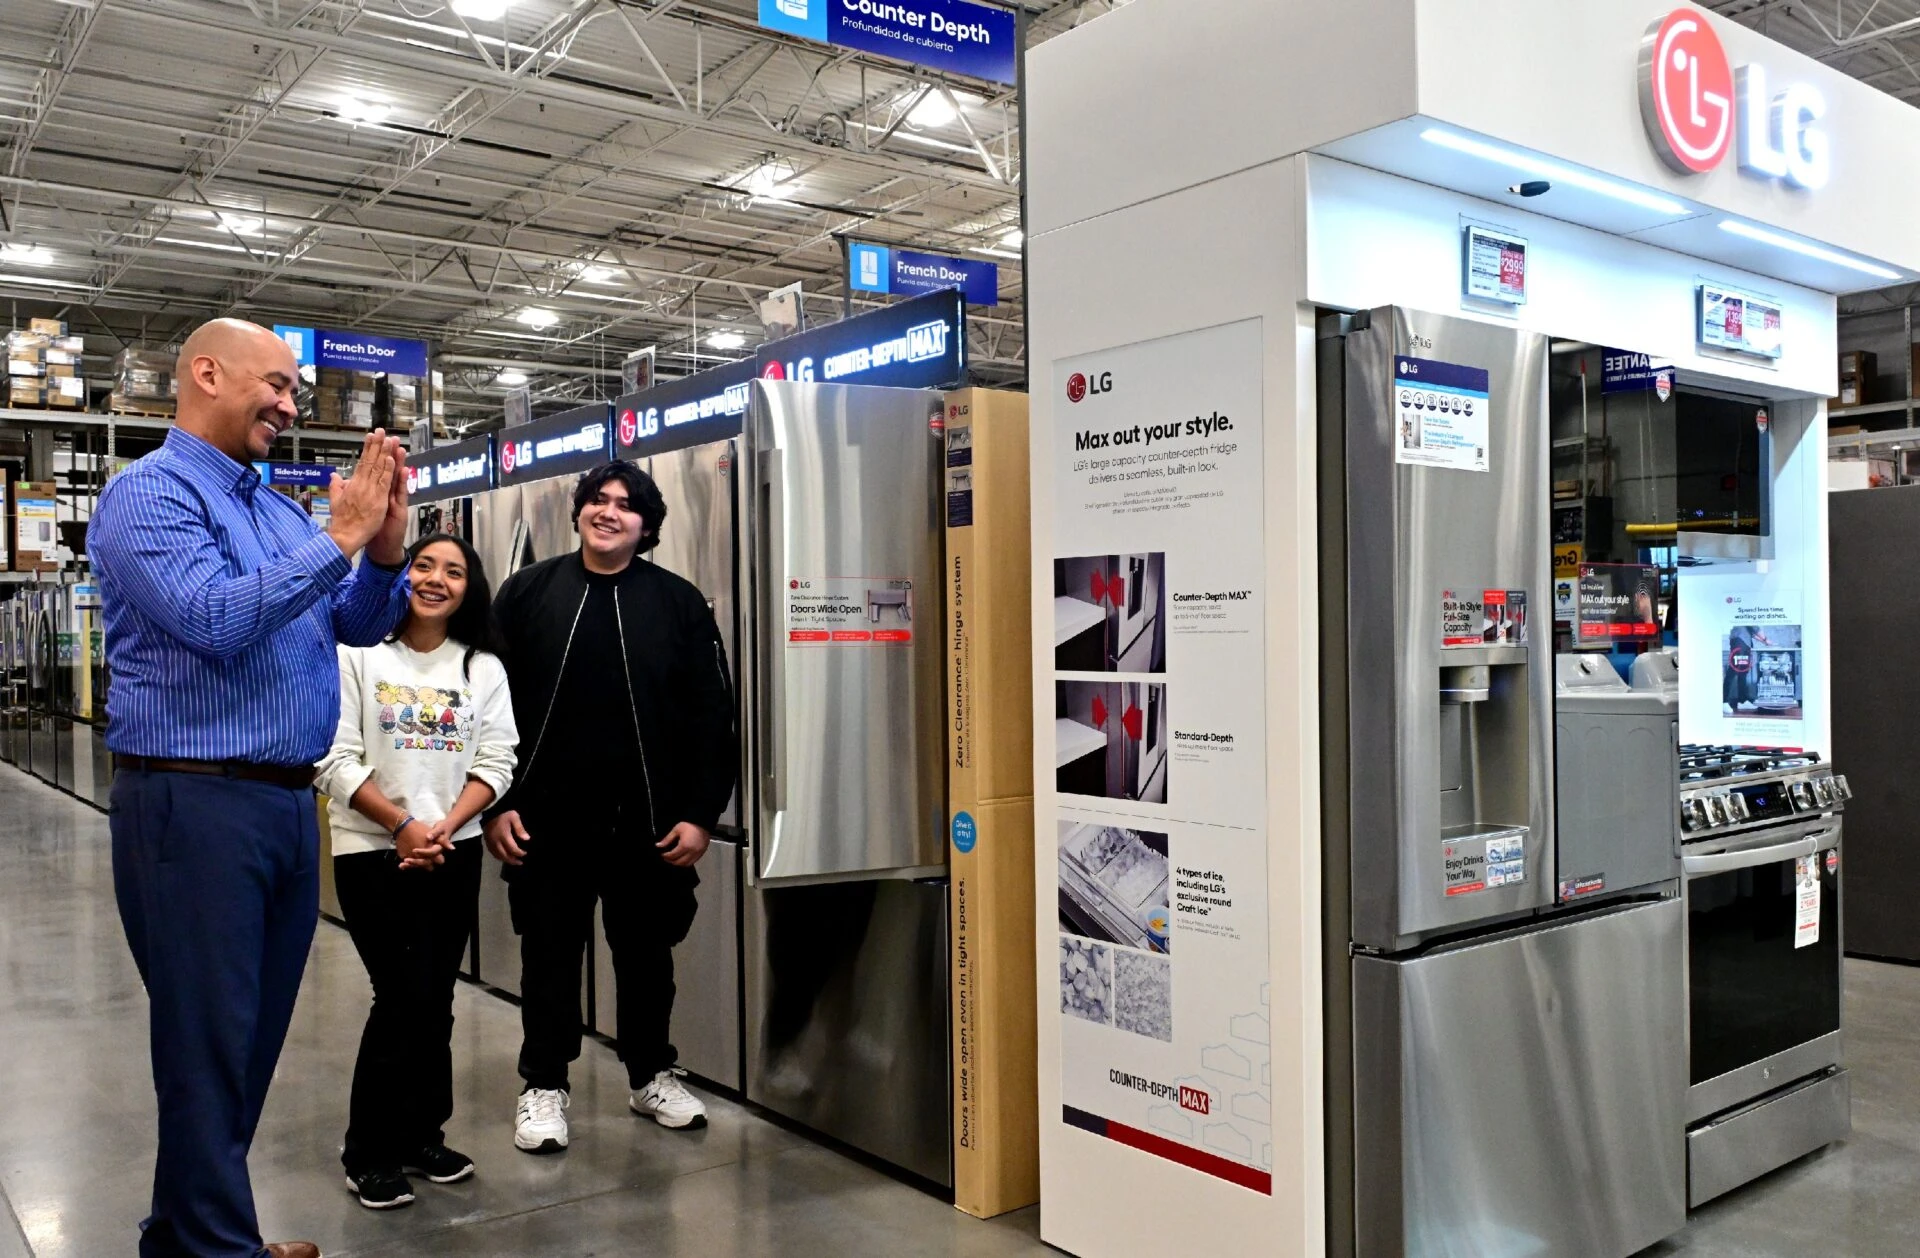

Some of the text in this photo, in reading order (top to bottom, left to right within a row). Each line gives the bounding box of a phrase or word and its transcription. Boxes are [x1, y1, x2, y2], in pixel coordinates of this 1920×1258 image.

[843, 0, 990, 44] Counter Depth
[842, 17, 953, 52] Profundidad de cubierta
[1734, 62, 1829, 190] LG
[897, 261, 968, 281] French Door
[323, 339, 396, 357] French Door
[786, 357, 814, 382] LG
[910, 324, 944, 361] MAX
[1409, 364, 1418, 373] LG
[1090, 371, 1113, 395] LG
[958, 405, 969, 415] LG
[637, 413, 658, 438] LG
[1075, 411, 1234, 451] Max out your style.
[516, 441, 532, 466] LG
[1090, 458, 1110, 471] large
[1112, 452, 1147, 469] capacity
[1148, 446, 1209, 463] counter-depth
[1210, 442, 1238, 456] fridge
[274, 467, 321, 477] Side-by-Side
[417, 466, 431, 489] LG
[1088, 461, 1219, 485] delivers a seamless, built-in look.
[953, 556, 963, 606] system
[1173, 592, 1228, 602] Counter-Depth
[1581, 594, 1594, 603] MAX
[791, 605, 862, 614] Doors Wide Open
[1466, 602, 1482, 613] Style
[954, 611, 964, 650] hinge
[1443, 622, 1472, 634] Capacity
[395, 738, 464, 752] PEANUTS
[1174, 730, 1234, 743] Standard-Depth
[955, 736, 964, 768] Zero
[1445, 855, 1484, 870] Enjoy Drinks
[1176, 867, 1181, 875] 4
[1182, 868, 1202, 878] types
[1203, 871, 1212, 879] of
[1446, 869, 1476, 882] Your Way
[1176, 878, 1208, 893] including
[1176, 891, 1232, 907] exclusive round
[1176, 903, 1196, 914] Craft
[958, 877, 969, 1148] Doors wide open even in tight spaces.
[1109, 1068, 1208, 1112] COUNTER-DEPTH MAX
